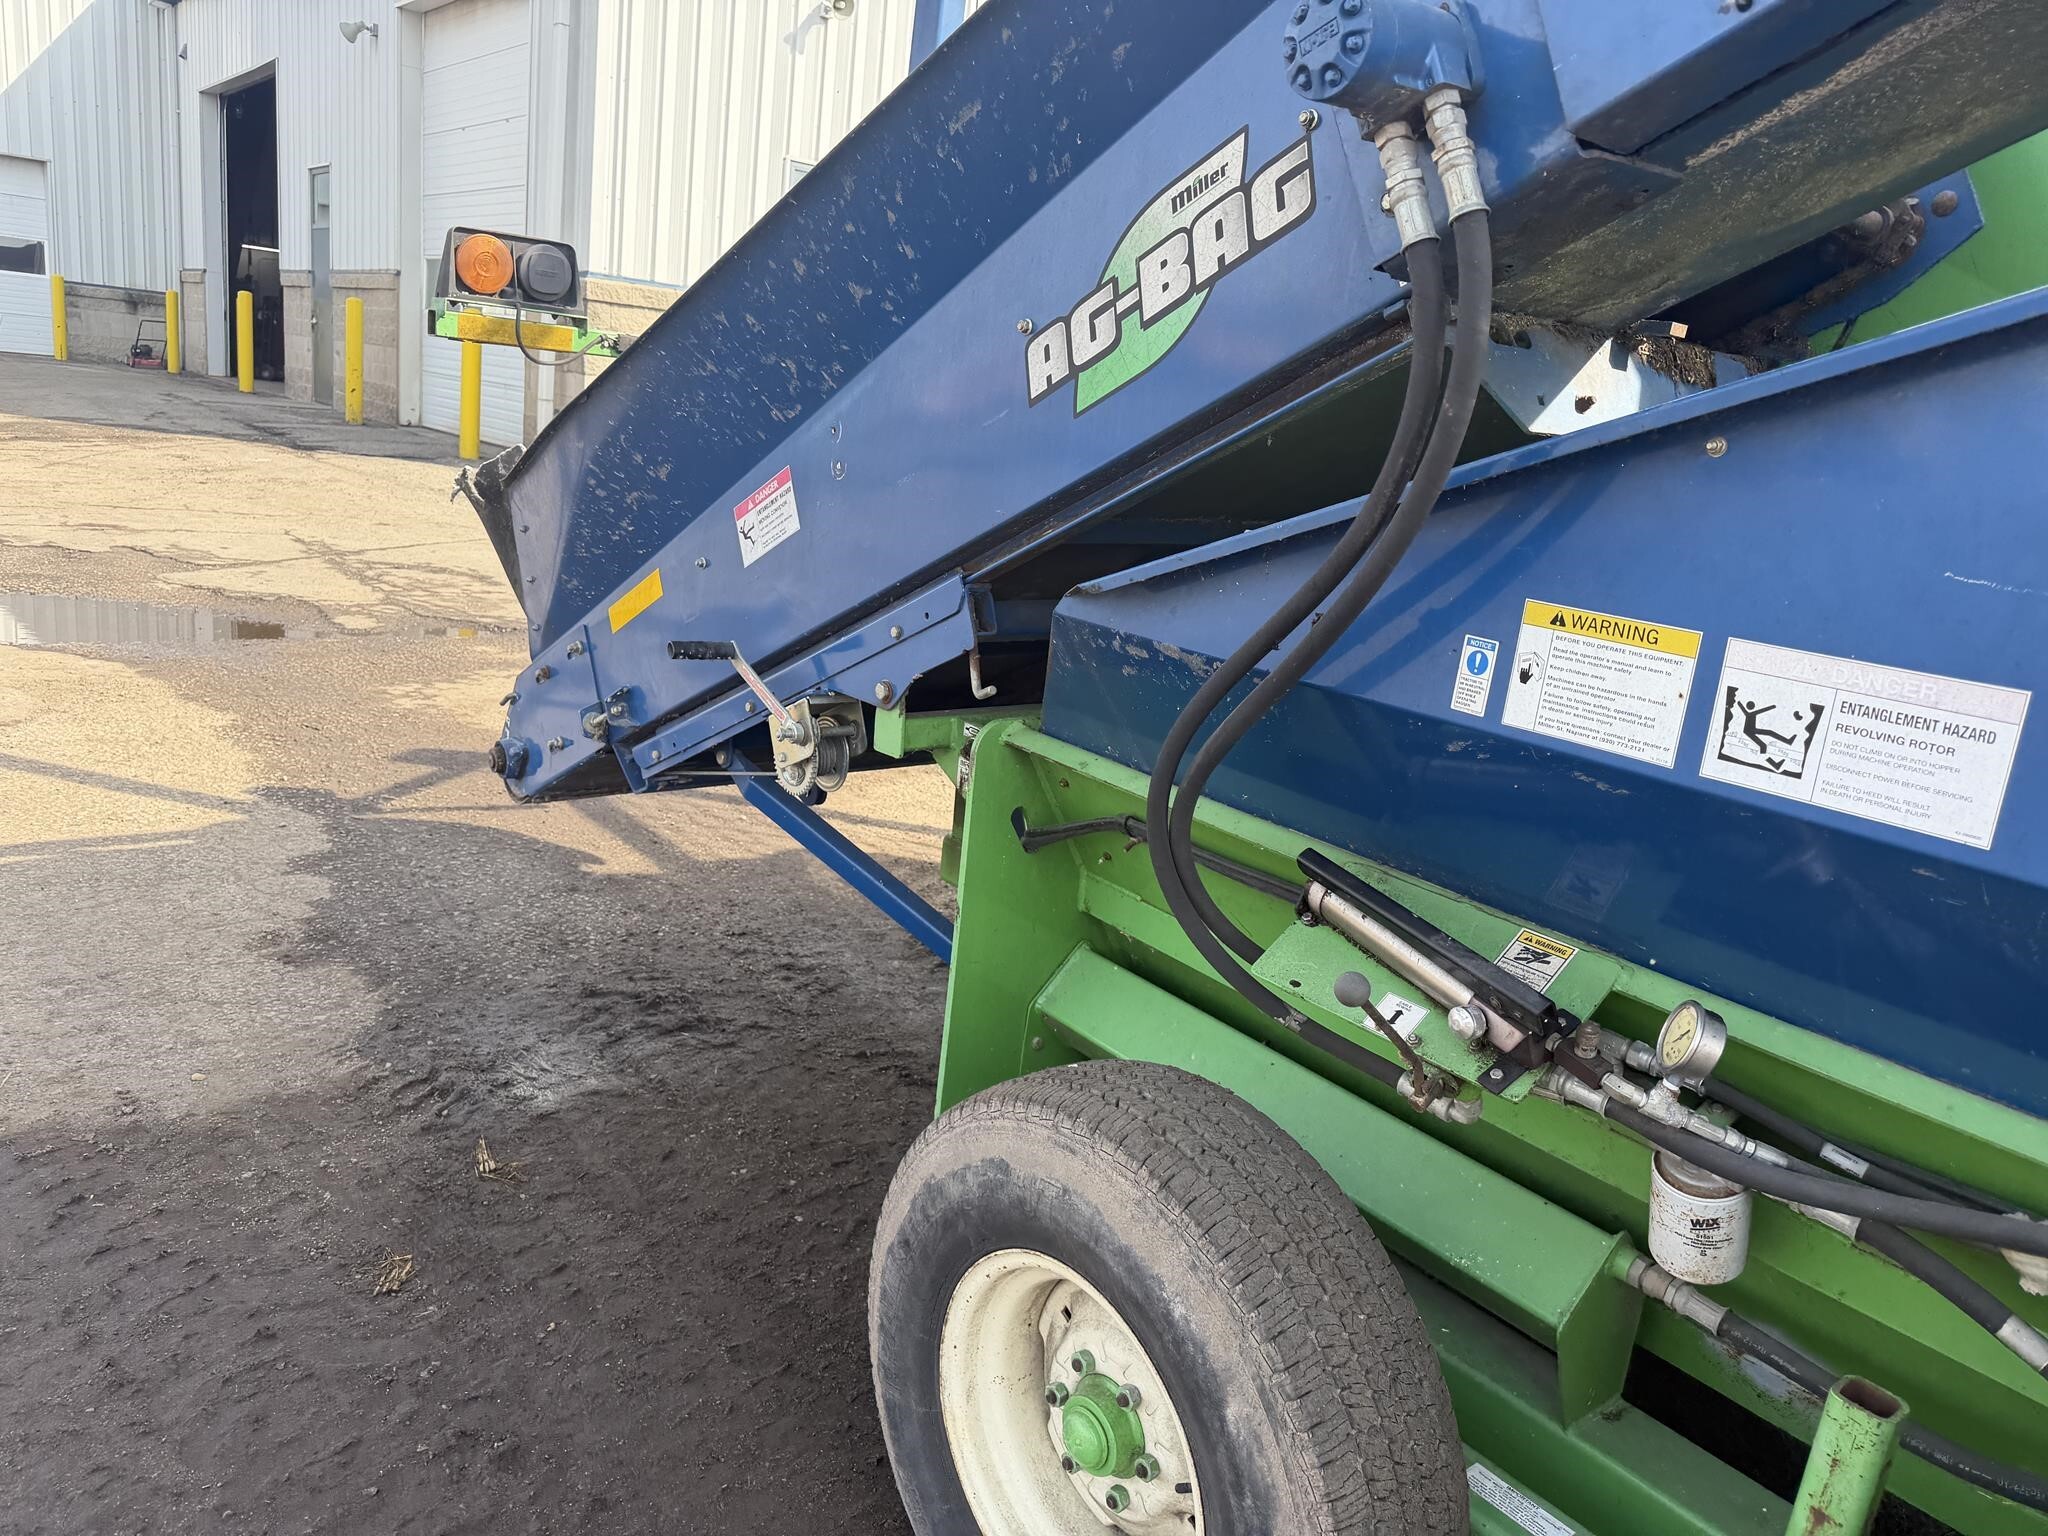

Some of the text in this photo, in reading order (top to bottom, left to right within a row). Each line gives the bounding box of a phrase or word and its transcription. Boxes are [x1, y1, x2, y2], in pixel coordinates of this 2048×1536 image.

[1027, 138, 1314, 402] AG-BAG
[755, 480, 779, 501] DANGER
[1470, 639, 1492, 649] NOTICE
[1569, 613, 1660, 645] WARNING
[1551, 652, 1573, 662] operate
[1574, 657, 1586, 665] this
[1586, 660, 1612, 671] machine
[1552, 646, 1568, 654] Read
[1610, 658, 1634, 668] manual
[1634, 663, 1647, 671] and
[1647, 666, 1664, 675] learn
[1555, 635, 1580, 644] BEFORE
[1581, 640, 1595, 648] YOU
[1596, 643, 1626, 654] OPERATE
[1627, 650, 1642, 658] THIS
[1549, 664, 1564, 672] Keep
[1565, 667, 1589, 677] children
[1830, 665, 1939, 701] DANGER
[1547, 674, 1574, 685] Machines
[1596, 686, 1628, 698] hazardous
[1647, 698, 1667, 707] hands
[1543, 691, 1564, 700] Failure
[1573, 698, 1591, 707] follow
[1612, 707, 1642, 719] operating
[1643, 714, 1656, 723] and
[1547, 706, 1564, 714] death
[1572, 712, 1595, 722] serious
[1581, 707, 1617, 720] instructions
[1618, 716, 1635, 725] could
[1636, 720, 1655, 729] result
[1838, 700, 1998, 745] ENTANGLEMENT HAZARD
[1555, 719, 1570, 727] have
[1603, 731, 1626, 741] contact
[1626, 737, 1641, 745] your
[1642, 741, 1662, 750] dealer
[1834, 722, 1956, 757] REVOLVING ROTOR
[1829, 747, 1935, 777] DURING MACHINE OPERATION
[1831, 739, 1960, 774] DO NOT CLIMB ON OR INTO HOPPER
[1821, 779, 1849, 791] FAILURE
[1851, 786, 1861, 794] TO
[1901, 798, 1930, 811] RESULT
[1825, 762, 1974, 803] DISCONNECT POWER BEFORE SERVICING
[1820, 786, 1931, 819] IN DEATH OR PERSONAL INJURY
[1533, 939, 1568, 955] WARNING
[1689, 1217, 1721, 1228] WIX
